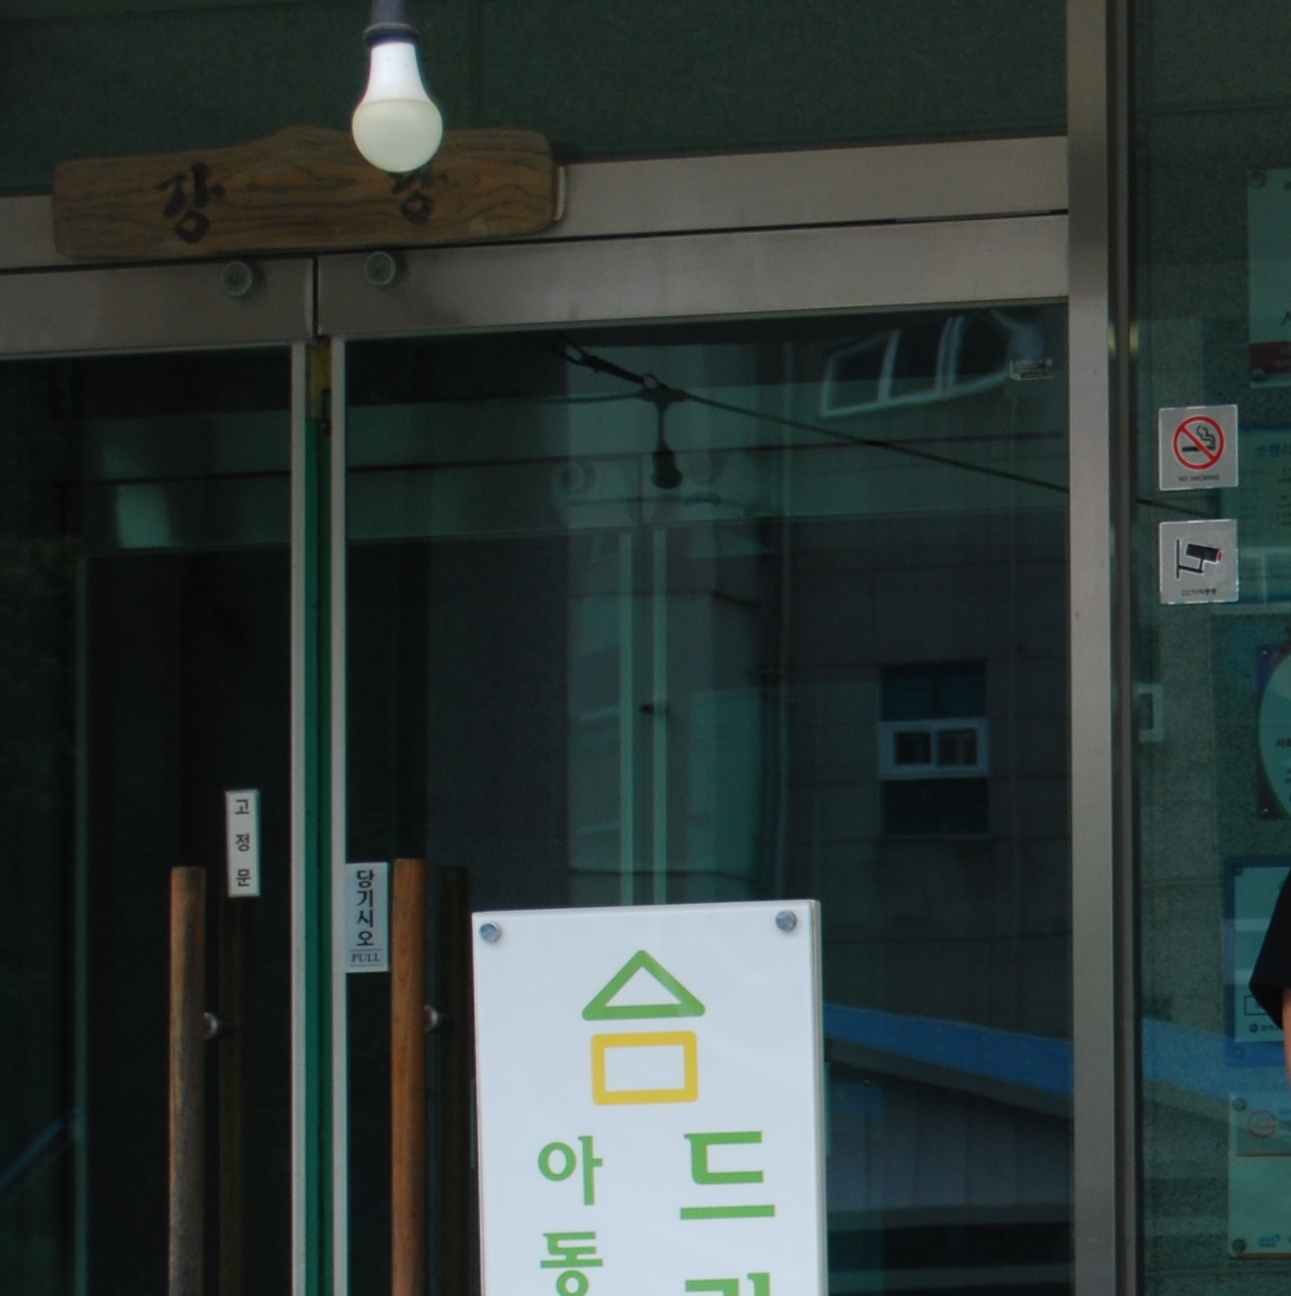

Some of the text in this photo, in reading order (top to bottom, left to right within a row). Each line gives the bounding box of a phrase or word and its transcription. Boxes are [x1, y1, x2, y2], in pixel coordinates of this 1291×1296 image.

[235, 799, 251, 887] 고정문
[356, 870, 375, 946] 당기시오
[352, 953, 381, 963] PULL
